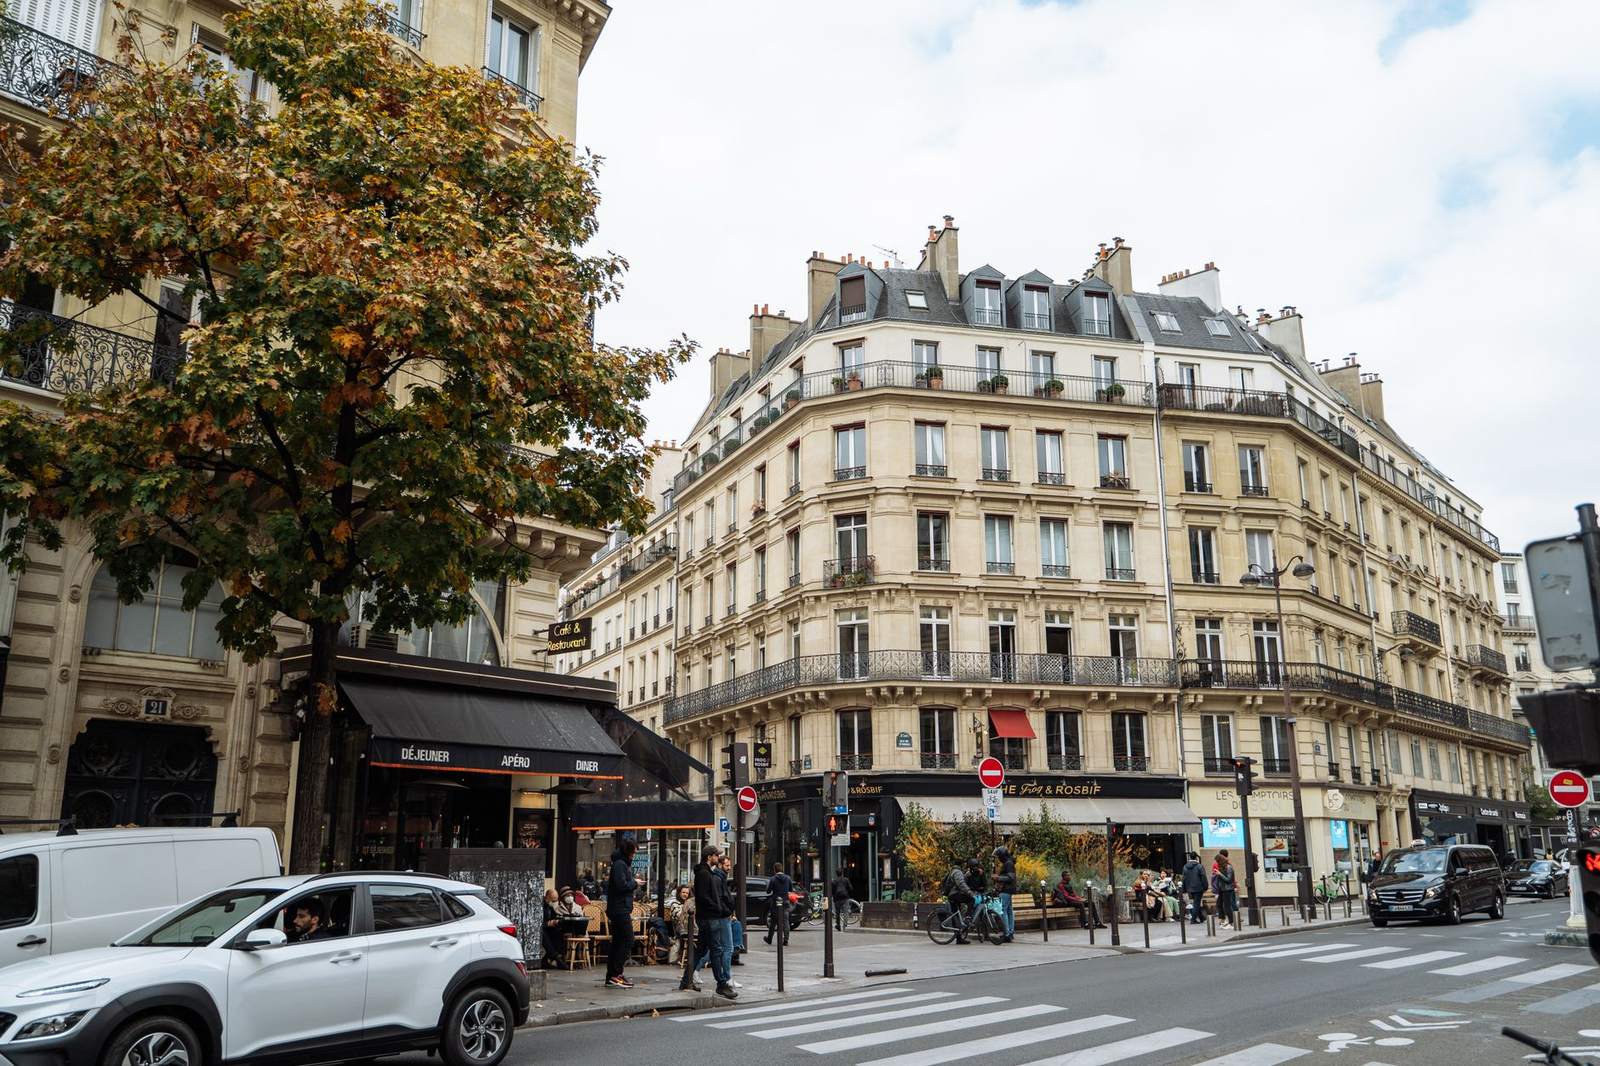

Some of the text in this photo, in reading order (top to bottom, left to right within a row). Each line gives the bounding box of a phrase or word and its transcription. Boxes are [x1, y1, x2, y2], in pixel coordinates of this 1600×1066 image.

[553, 622, 581, 636] Café &
[547, 637, 588, 651] Restaurant
[150, 701, 162, 714] 21
[401, 745, 450, 763] DÉJEUNER
[501, 753, 531, 769] APÉRO
[576, 759, 599, 772] DINER
[856, 786, 883, 794] ROSBIF
[1000, 783, 1102, 795] HE Frog & ROSBIF
[1215, 790, 1295, 801] LES MPTOIRS
[1251, 801, 1281, 811] SOIN
[721, 820, 729, 830] P
